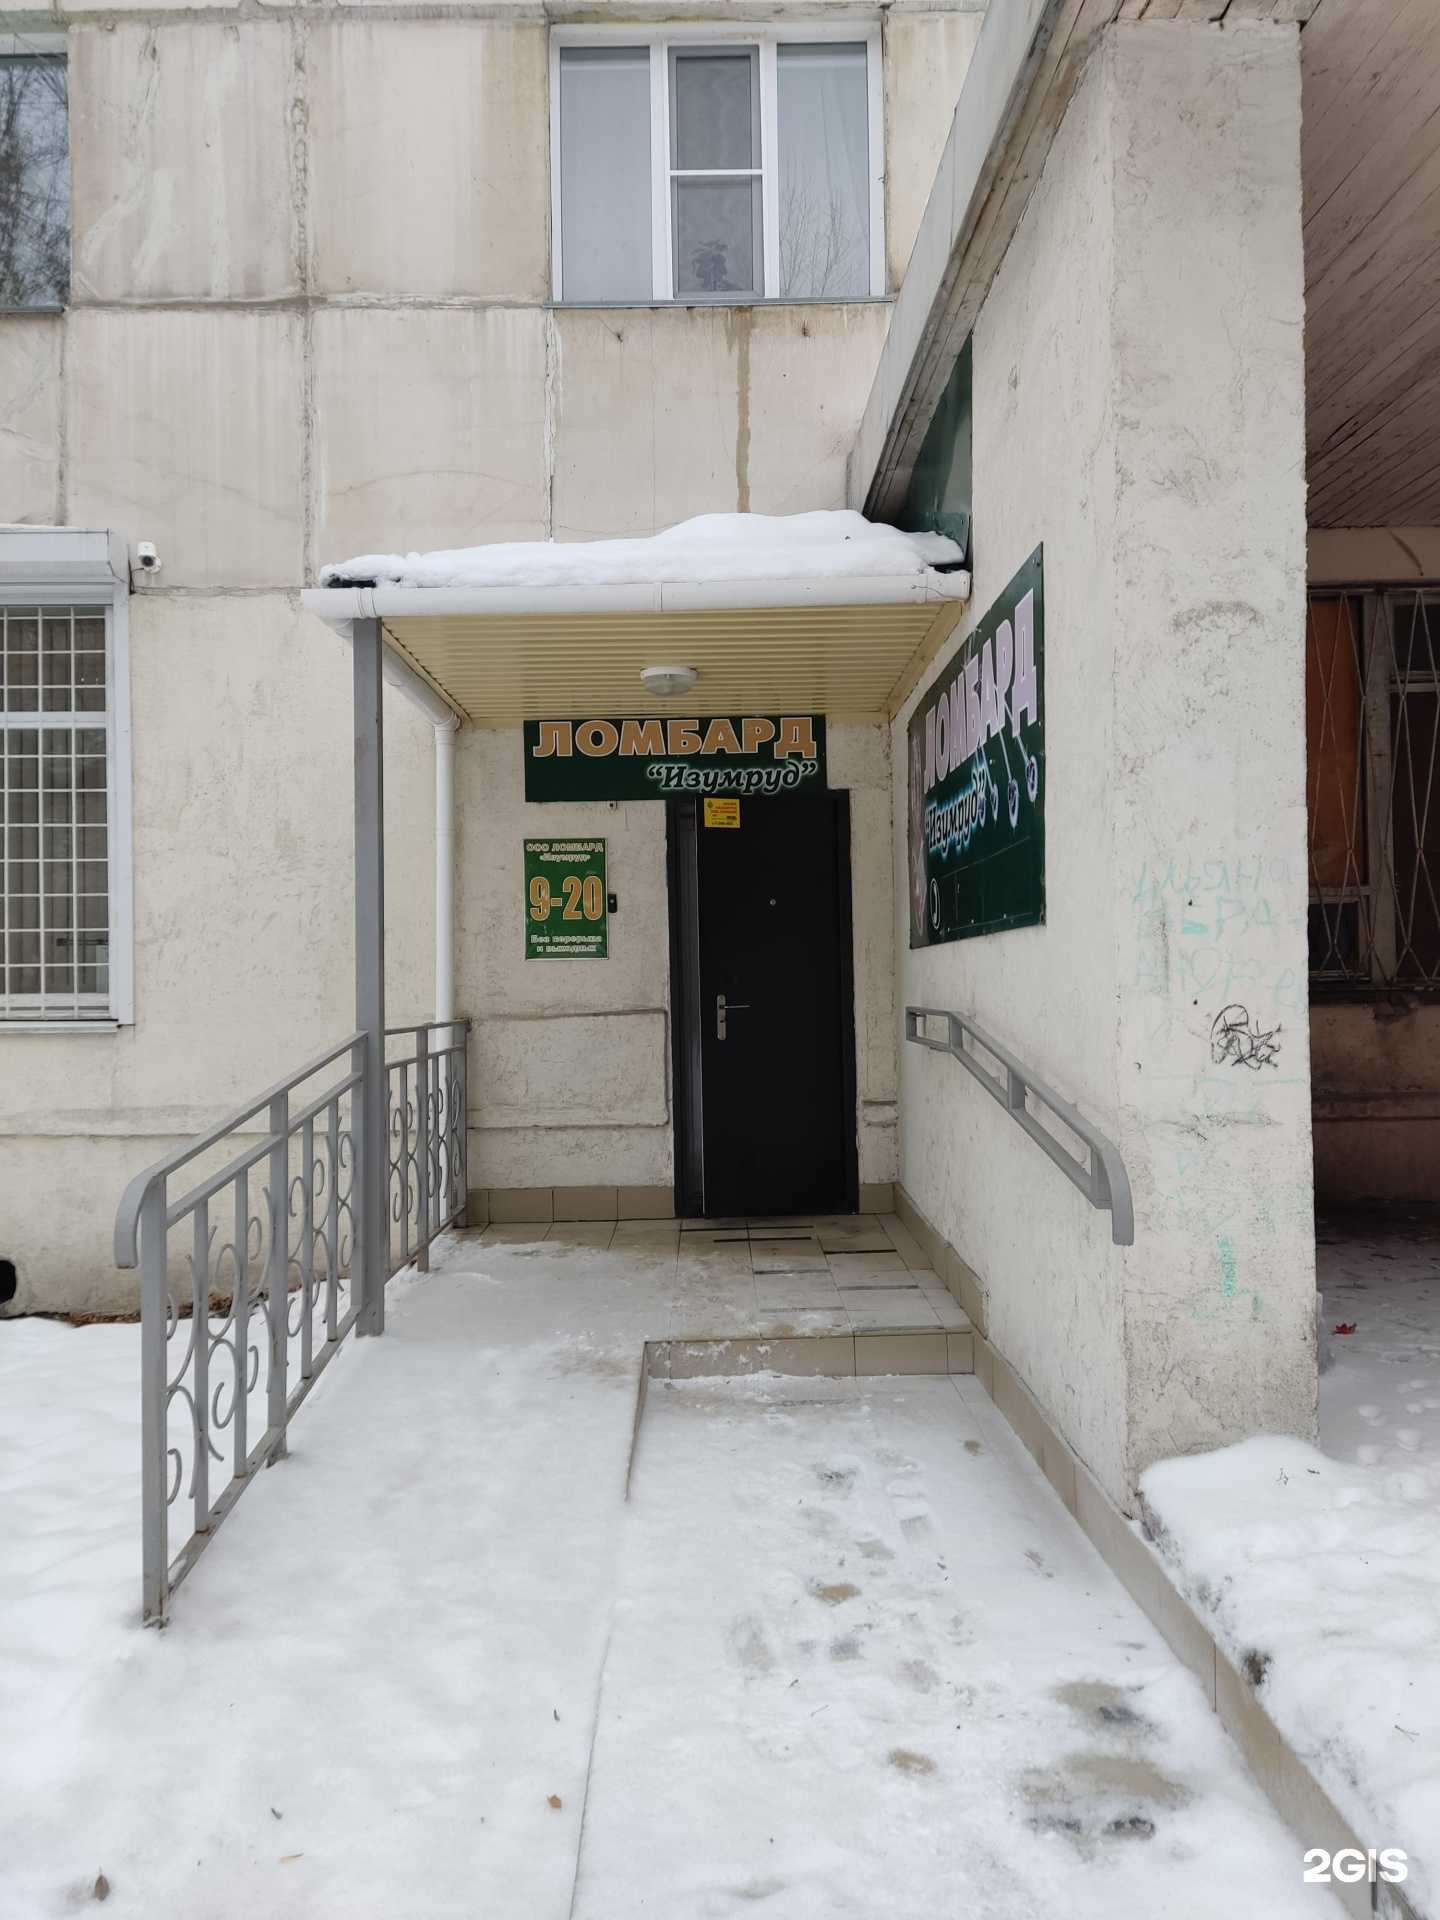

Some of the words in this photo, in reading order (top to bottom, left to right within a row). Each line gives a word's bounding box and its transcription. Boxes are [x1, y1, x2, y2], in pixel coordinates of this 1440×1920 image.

[924, 588, 1037, 795] ЛОМБАРД
[533, 717, 817, 759] ЛОМБАРД
[526, 842, 550, 852] ООО
[551, 842, 604, 853] ЛОМБАРД
[529, 875, 603, 921] 9-20
